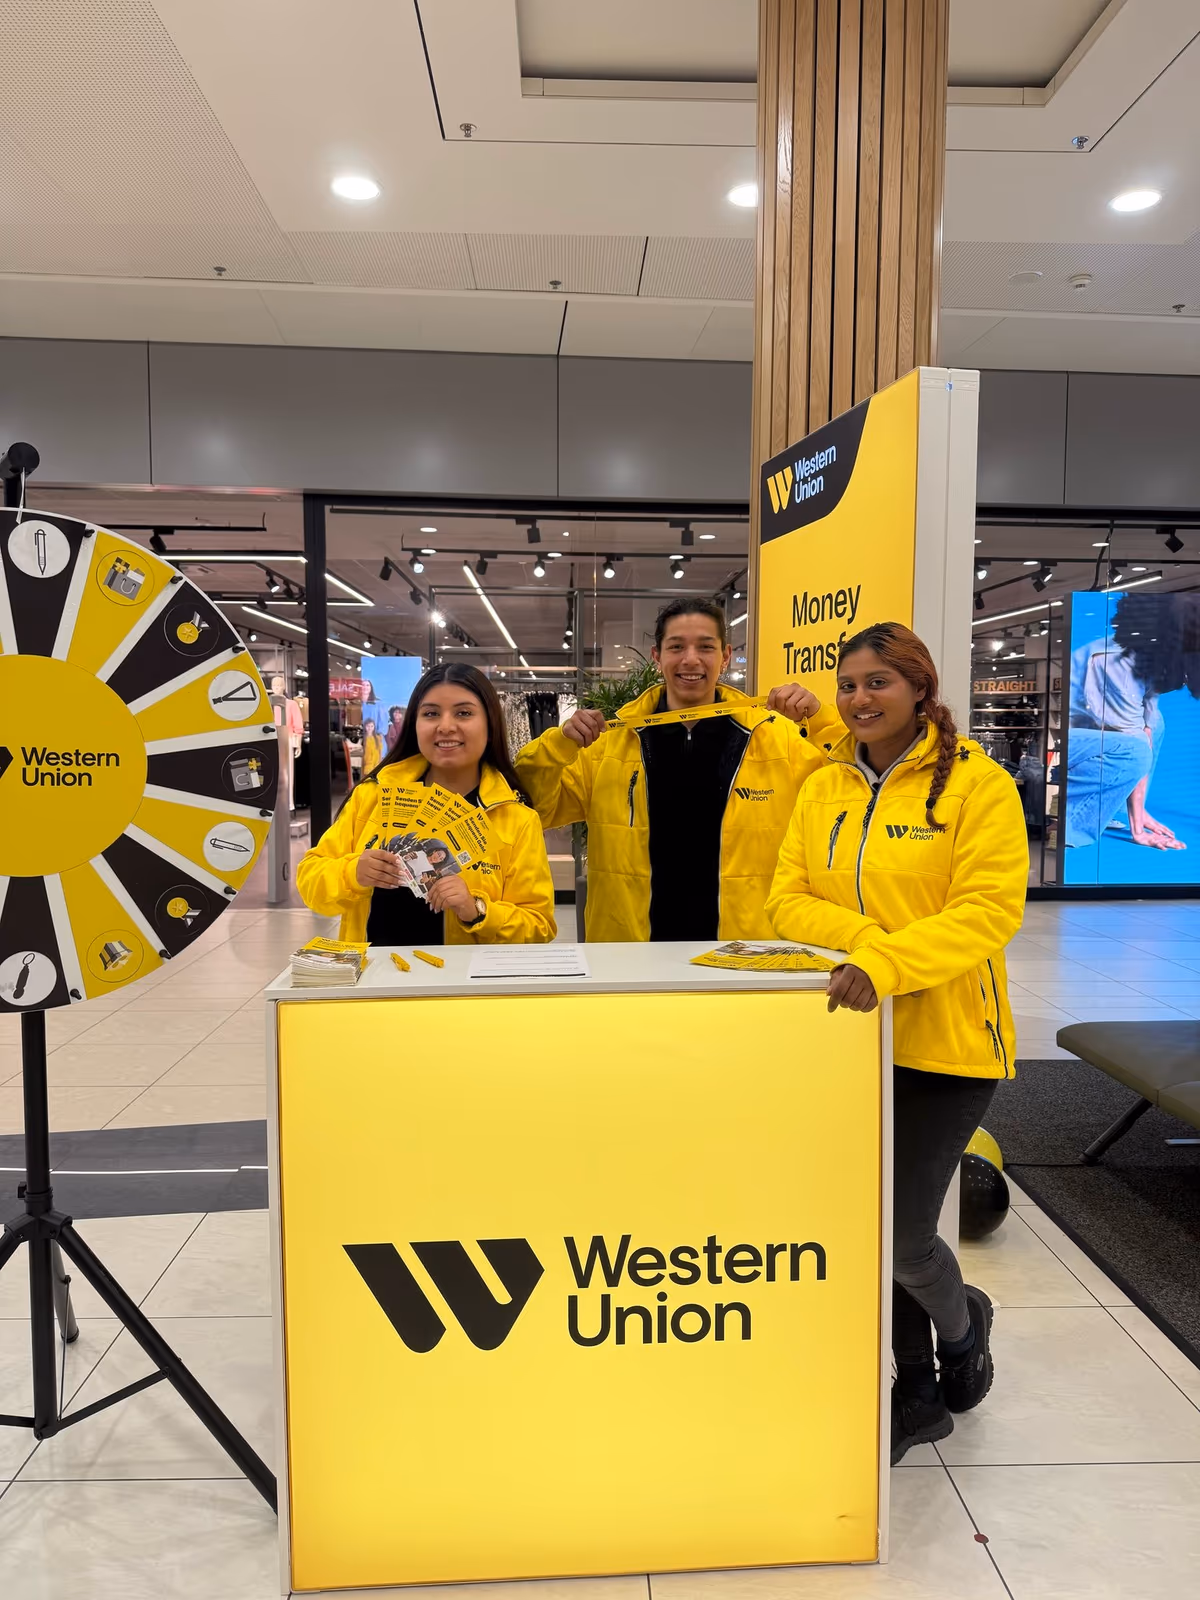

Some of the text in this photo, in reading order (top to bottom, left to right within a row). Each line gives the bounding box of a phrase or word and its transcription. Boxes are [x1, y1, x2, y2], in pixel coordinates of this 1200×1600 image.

[795, 445, 836, 482] Western
[795, 475, 824, 504] Union
[792, 584, 861, 628] Money
[973, 681, 1036, 692] STRAIGHT
[21, 746, 120, 767] Western
[22, 768, 92, 787] Union
[909, 832, 934, 841] Union
[563, 1234, 827, 1289] Western
[568, 1291, 752, 1347] Union
